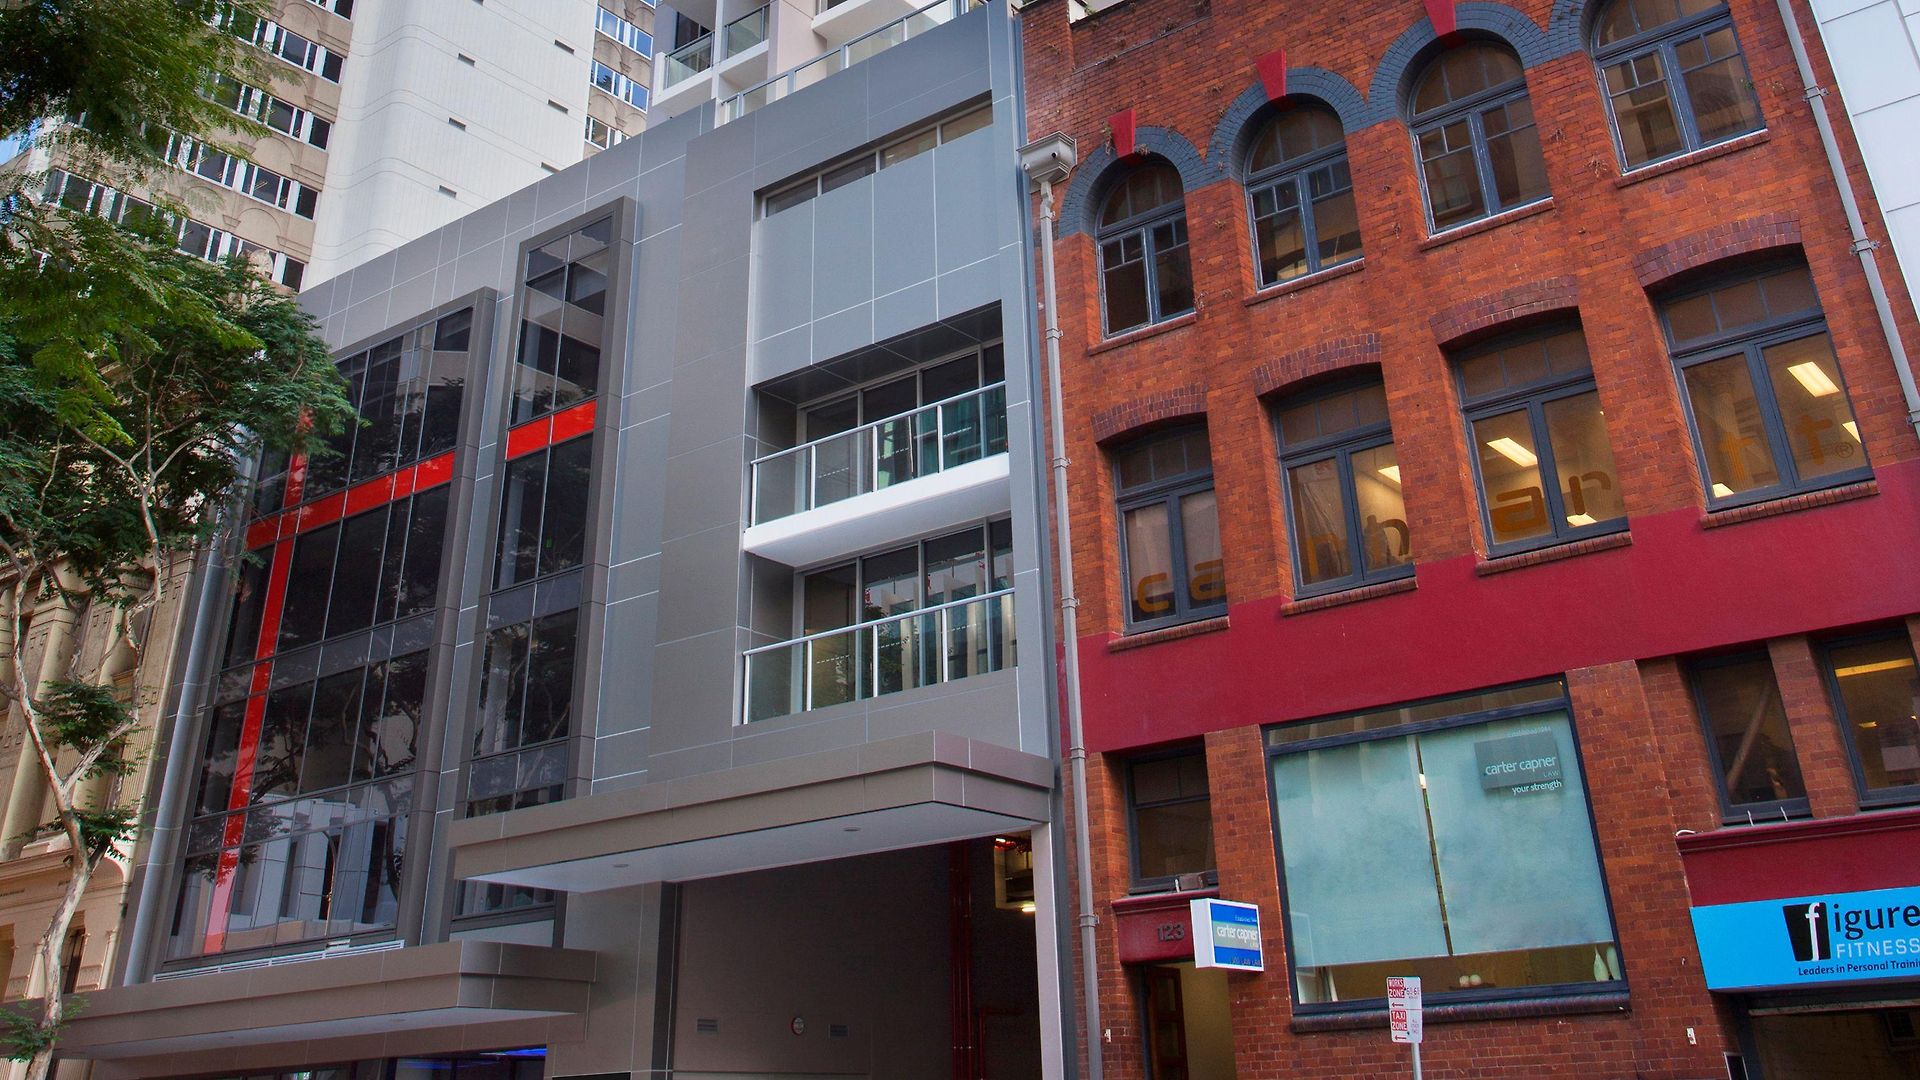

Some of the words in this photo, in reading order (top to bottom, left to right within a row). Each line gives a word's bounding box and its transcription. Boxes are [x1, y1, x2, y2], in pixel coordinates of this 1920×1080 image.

[1485, 761, 1517, 775] carter
[1519, 756, 1556, 772] capner
[1512, 784, 1530, 796] your
[1530, 779, 1562, 792] strength
[1157, 923, 1185, 941] 123
[1216, 925, 1236, 937] carter
[1236, 927, 1258, 943] capner
[1836, 938, 1920, 959] FITNESS
[1798, 966, 1835, 976] Leaders
[1836, 964, 1845, 973] in
[1847, 963, 1889, 973] Personal
[1891, 959, 1920, 969] Traini
[1389, 988, 1405, 998] ZONE
[1391, 1011, 1406, 1020] TAXI
[1392, 1021, 1408, 1031] ZONE
